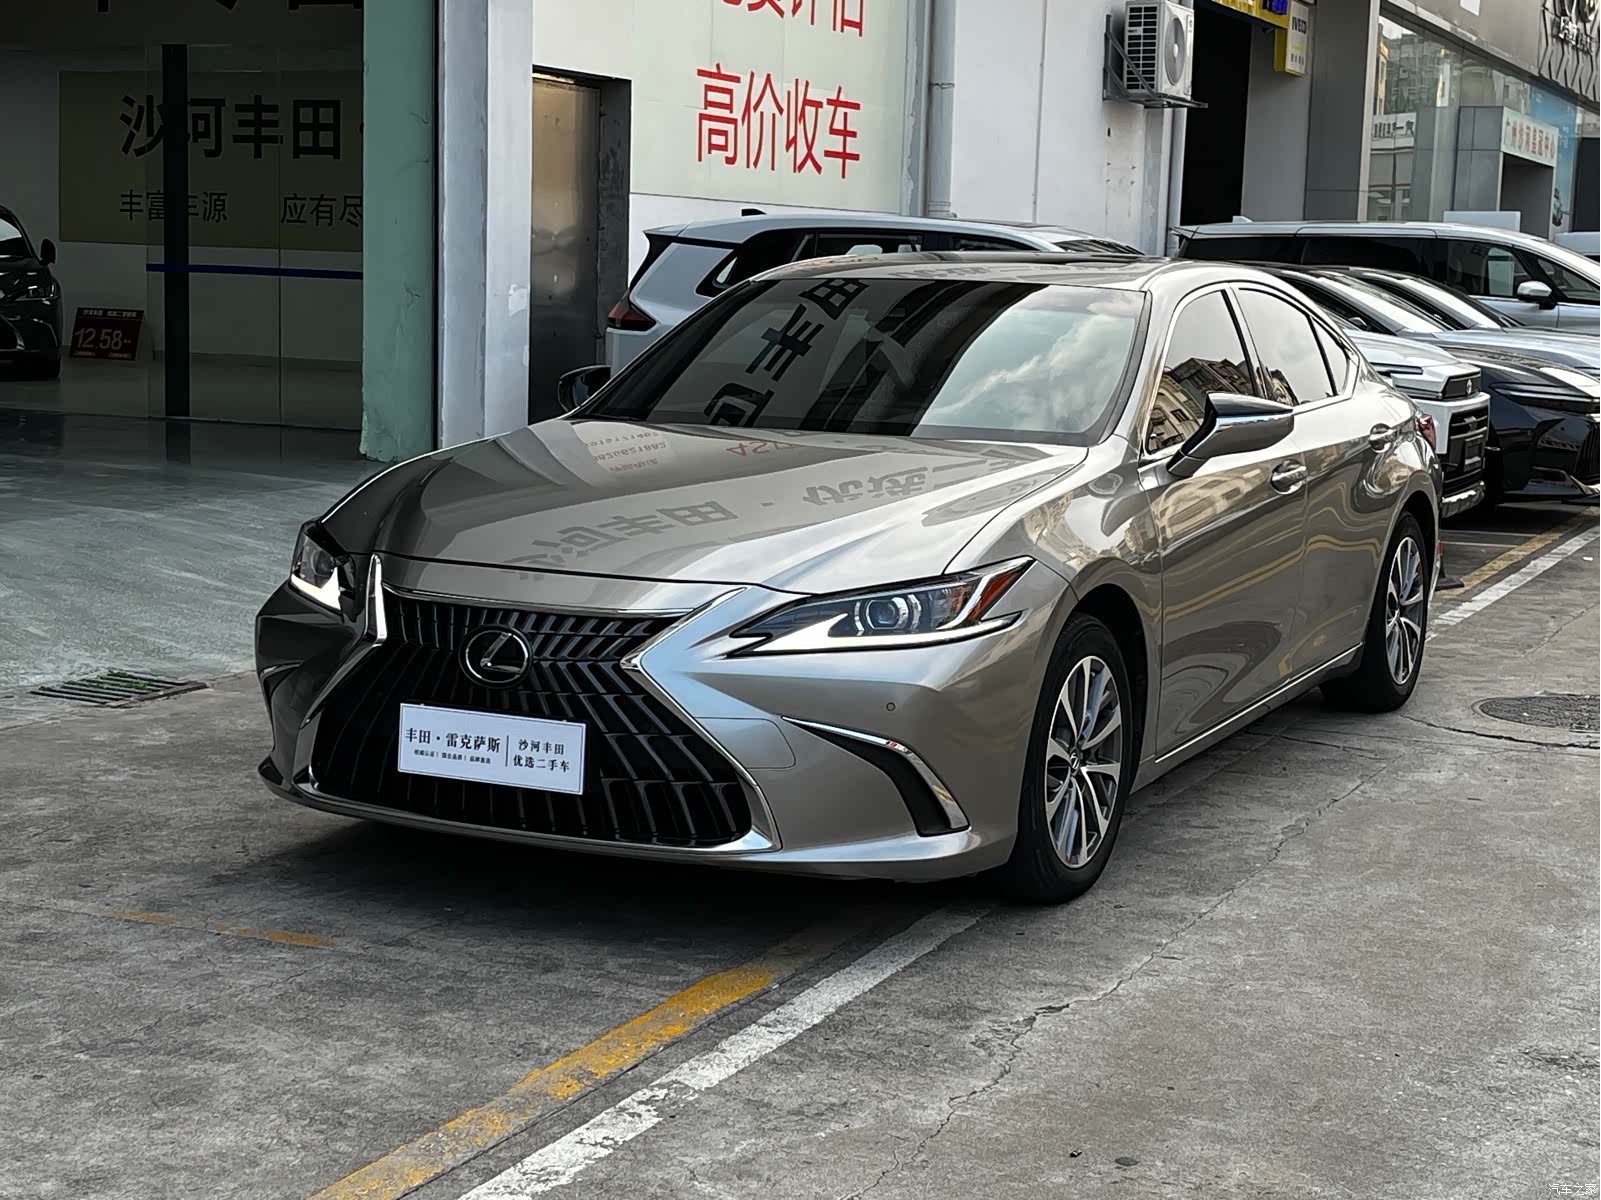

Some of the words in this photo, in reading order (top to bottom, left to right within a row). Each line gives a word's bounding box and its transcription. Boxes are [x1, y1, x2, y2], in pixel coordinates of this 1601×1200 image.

[697, 63, 861, 179] 高价收车
[74, 327, 123, 350] 12.58
[404, 728, 501, 752] 丰田·雷克萨斯
[518, 739, 565, 755] 沙河丰田
[513, 755, 570, 773] 优选二手车
